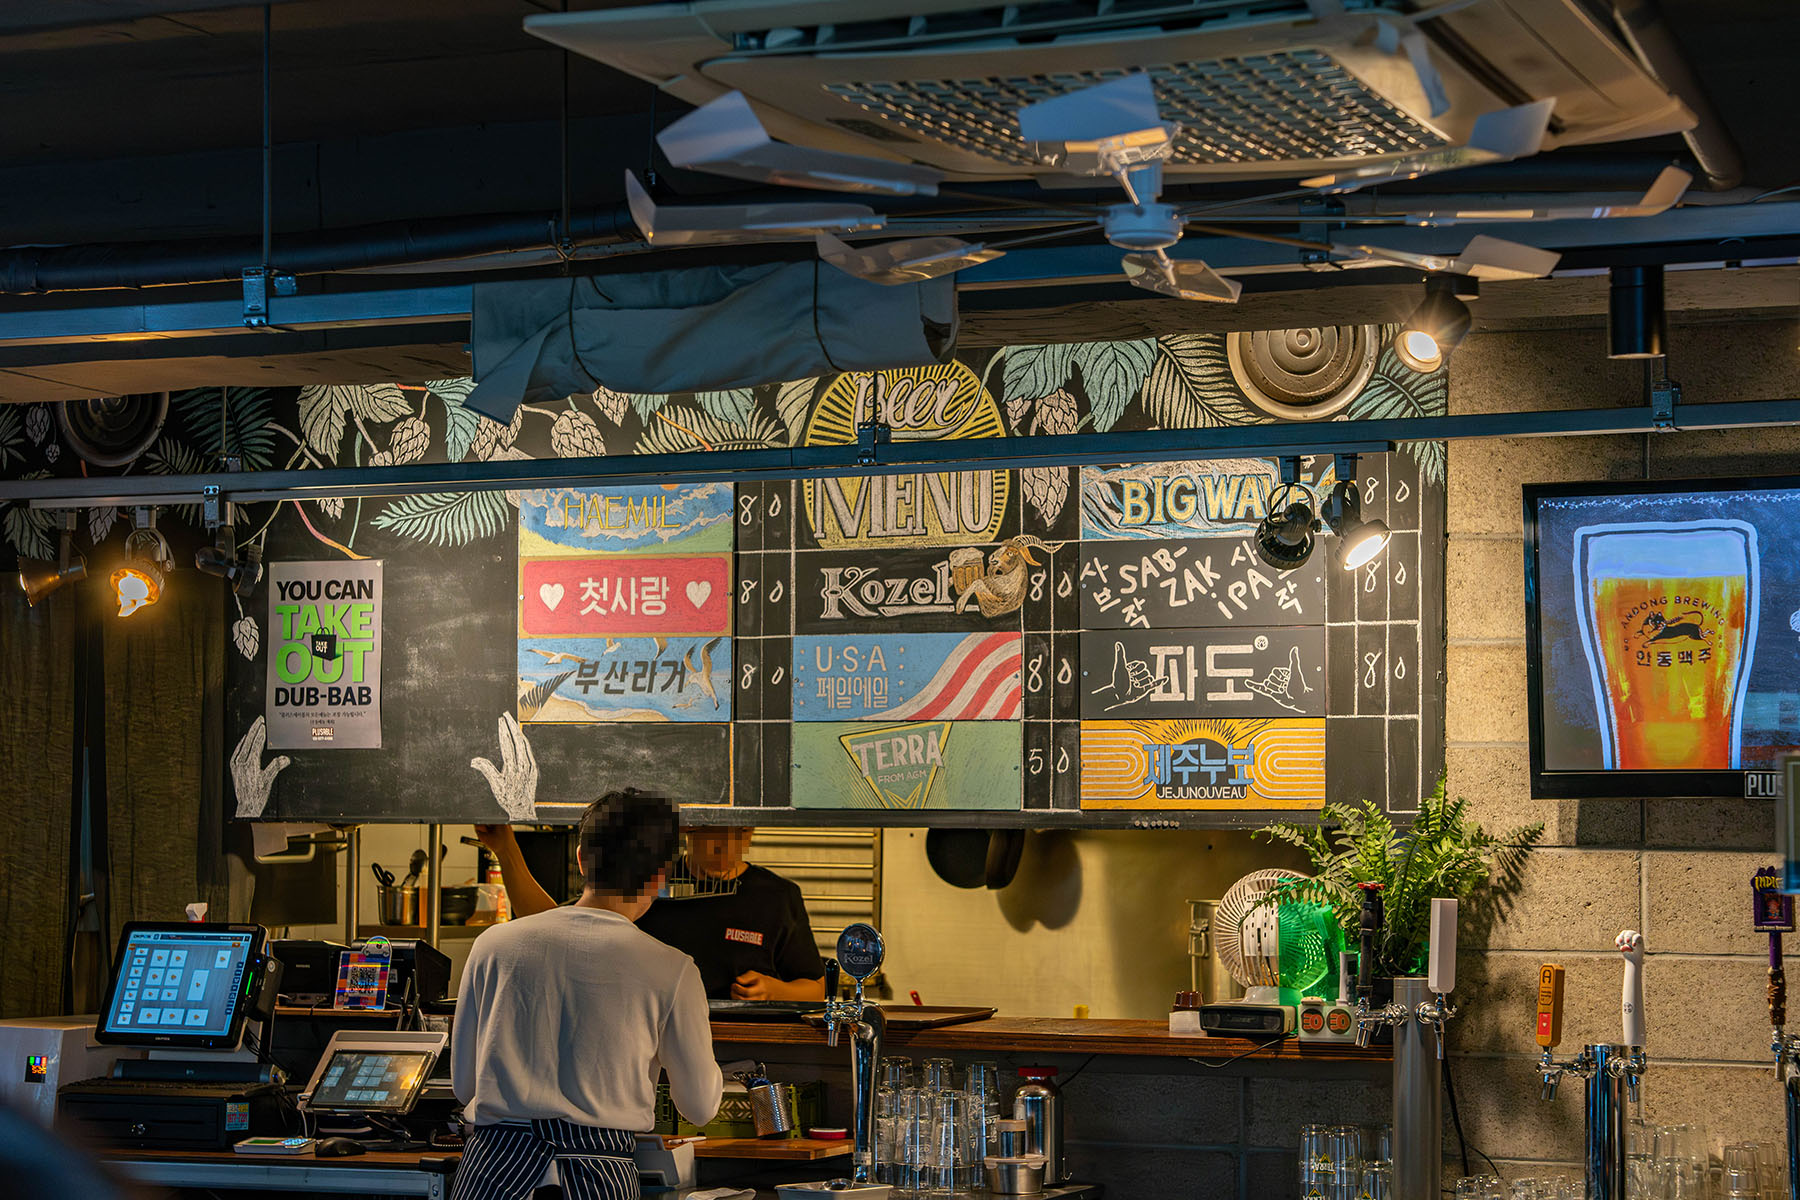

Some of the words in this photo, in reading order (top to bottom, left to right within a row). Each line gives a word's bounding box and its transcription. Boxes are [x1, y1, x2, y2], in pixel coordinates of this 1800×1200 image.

[853, 373, 962, 434] Beer
[564, 496, 681, 530] HAEMIL
[814, 470, 993, 539] MENU
[1118, 476, 1199, 527] BIG
[277, 580, 322, 601] YOU
[325, 579, 374, 600] CAN
[579, 576, 670, 617] 첫사랑
[820, 560, 954, 619] Kozel
[1160, 556, 1221, 608] ZAK
[275, 603, 374, 640] TAKE
[1621, 596, 1668, 629] ANDONG
[1674, 595, 1726, 626] BREWING
[275, 642, 374, 684] OUT
[315, 645, 328, 653] OUT
[575, 659, 686, 695] 부산라거
[1149, 644, 1254, 701] 파도
[274, 686, 372, 707] DUB-BAB
[816, 676, 888, 709] 페일에일
[312, 728, 334, 736] PLUSABLE
[851, 730, 945, 778] TERRA
[1143, 743, 1255, 786] 제주누보
[877, 773, 905, 784] FROM
[907, 769, 927, 780] AGM
[1156, 786, 1248, 799] JEJUNOUVEAU
[725, 928, 763, 945] PLUSABLE
[843, 953, 873, 964] Kozel
